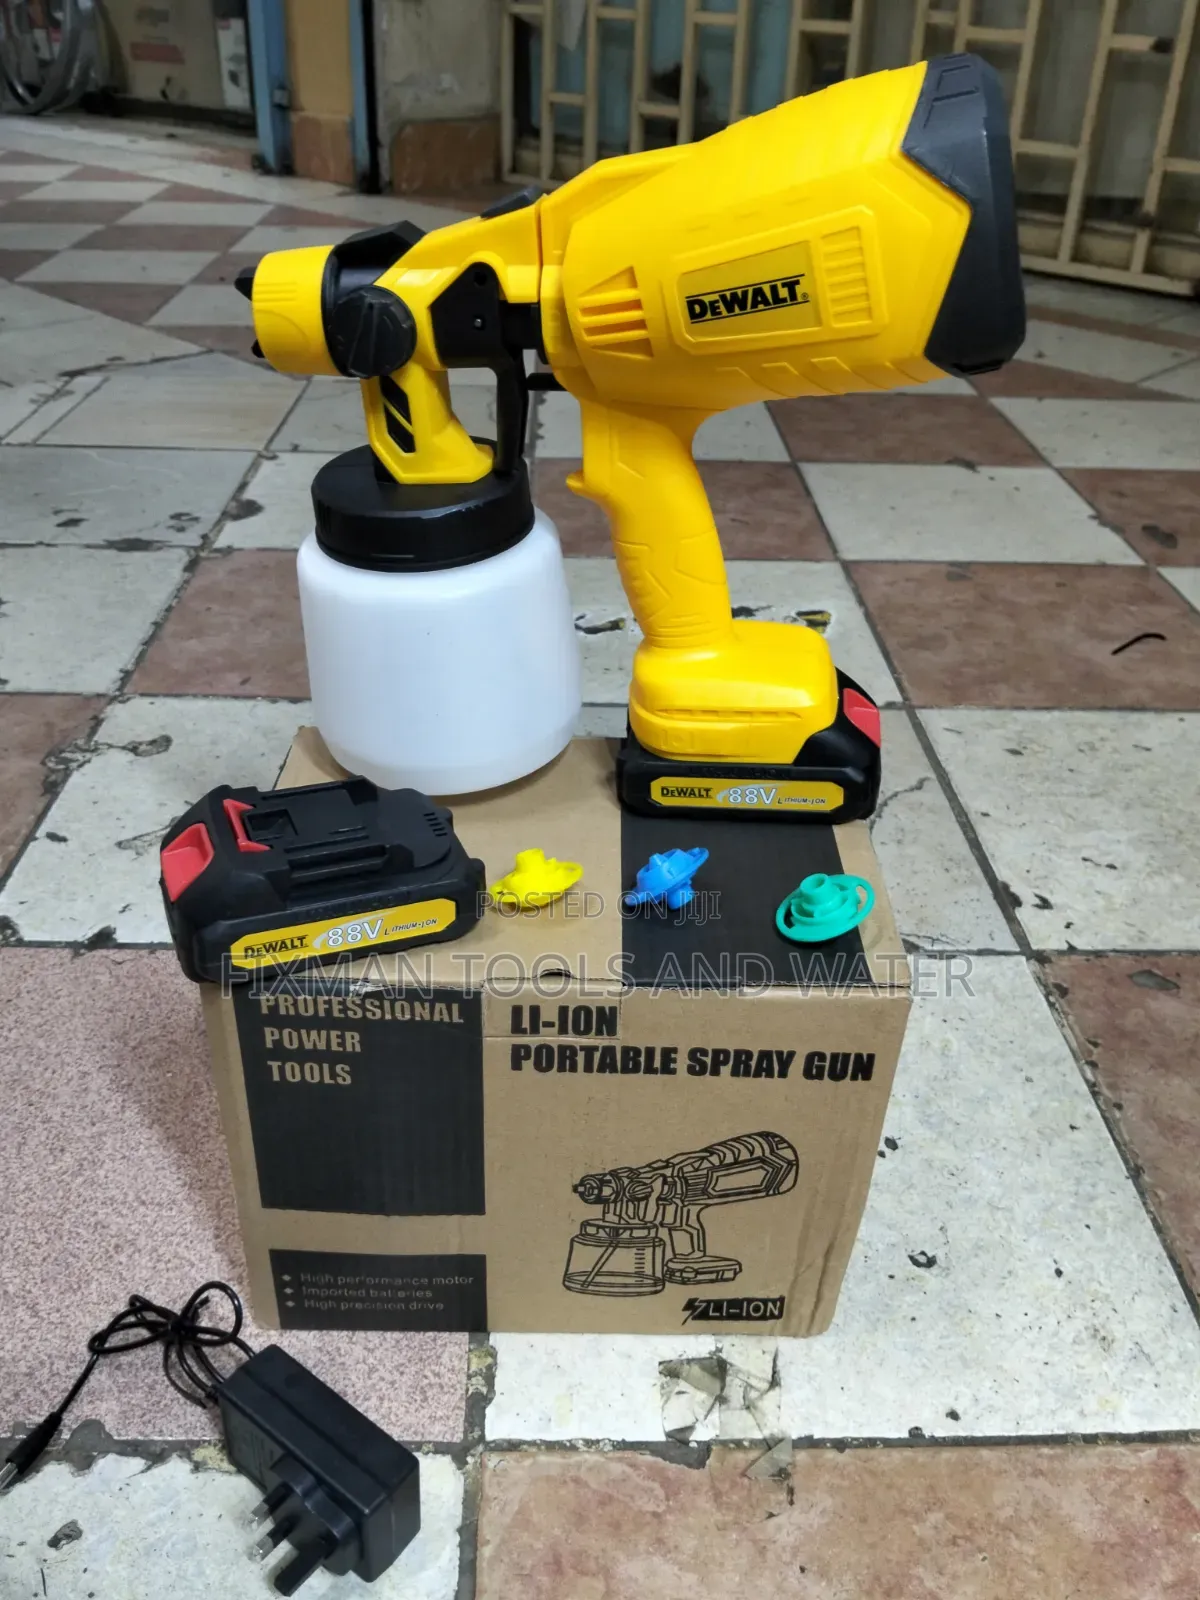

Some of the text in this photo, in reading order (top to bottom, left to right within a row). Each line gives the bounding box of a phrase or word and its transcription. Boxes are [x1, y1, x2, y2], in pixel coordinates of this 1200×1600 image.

[728, 788, 777, 804] 88V
[327, 918, 383, 948] 88V
[260, 993, 464, 1023] PROFESSIONAL
[510, 1005, 618, 1036] LI-ION
[264, 1027, 361, 1052] POWER
[267, 1060, 352, 1085] TOOLS
[510, 1043, 876, 1082] PORTABLE SPRAY GUN
[300, 1273, 333, 1286] High
[433, 1275, 475, 1285] motor
[302, 1286, 367, 1299] Imported
[305, 1299, 337, 1312] High
[409, 1300, 445, 1311] drive
[709, 1301, 780, 1317] LI-ION
